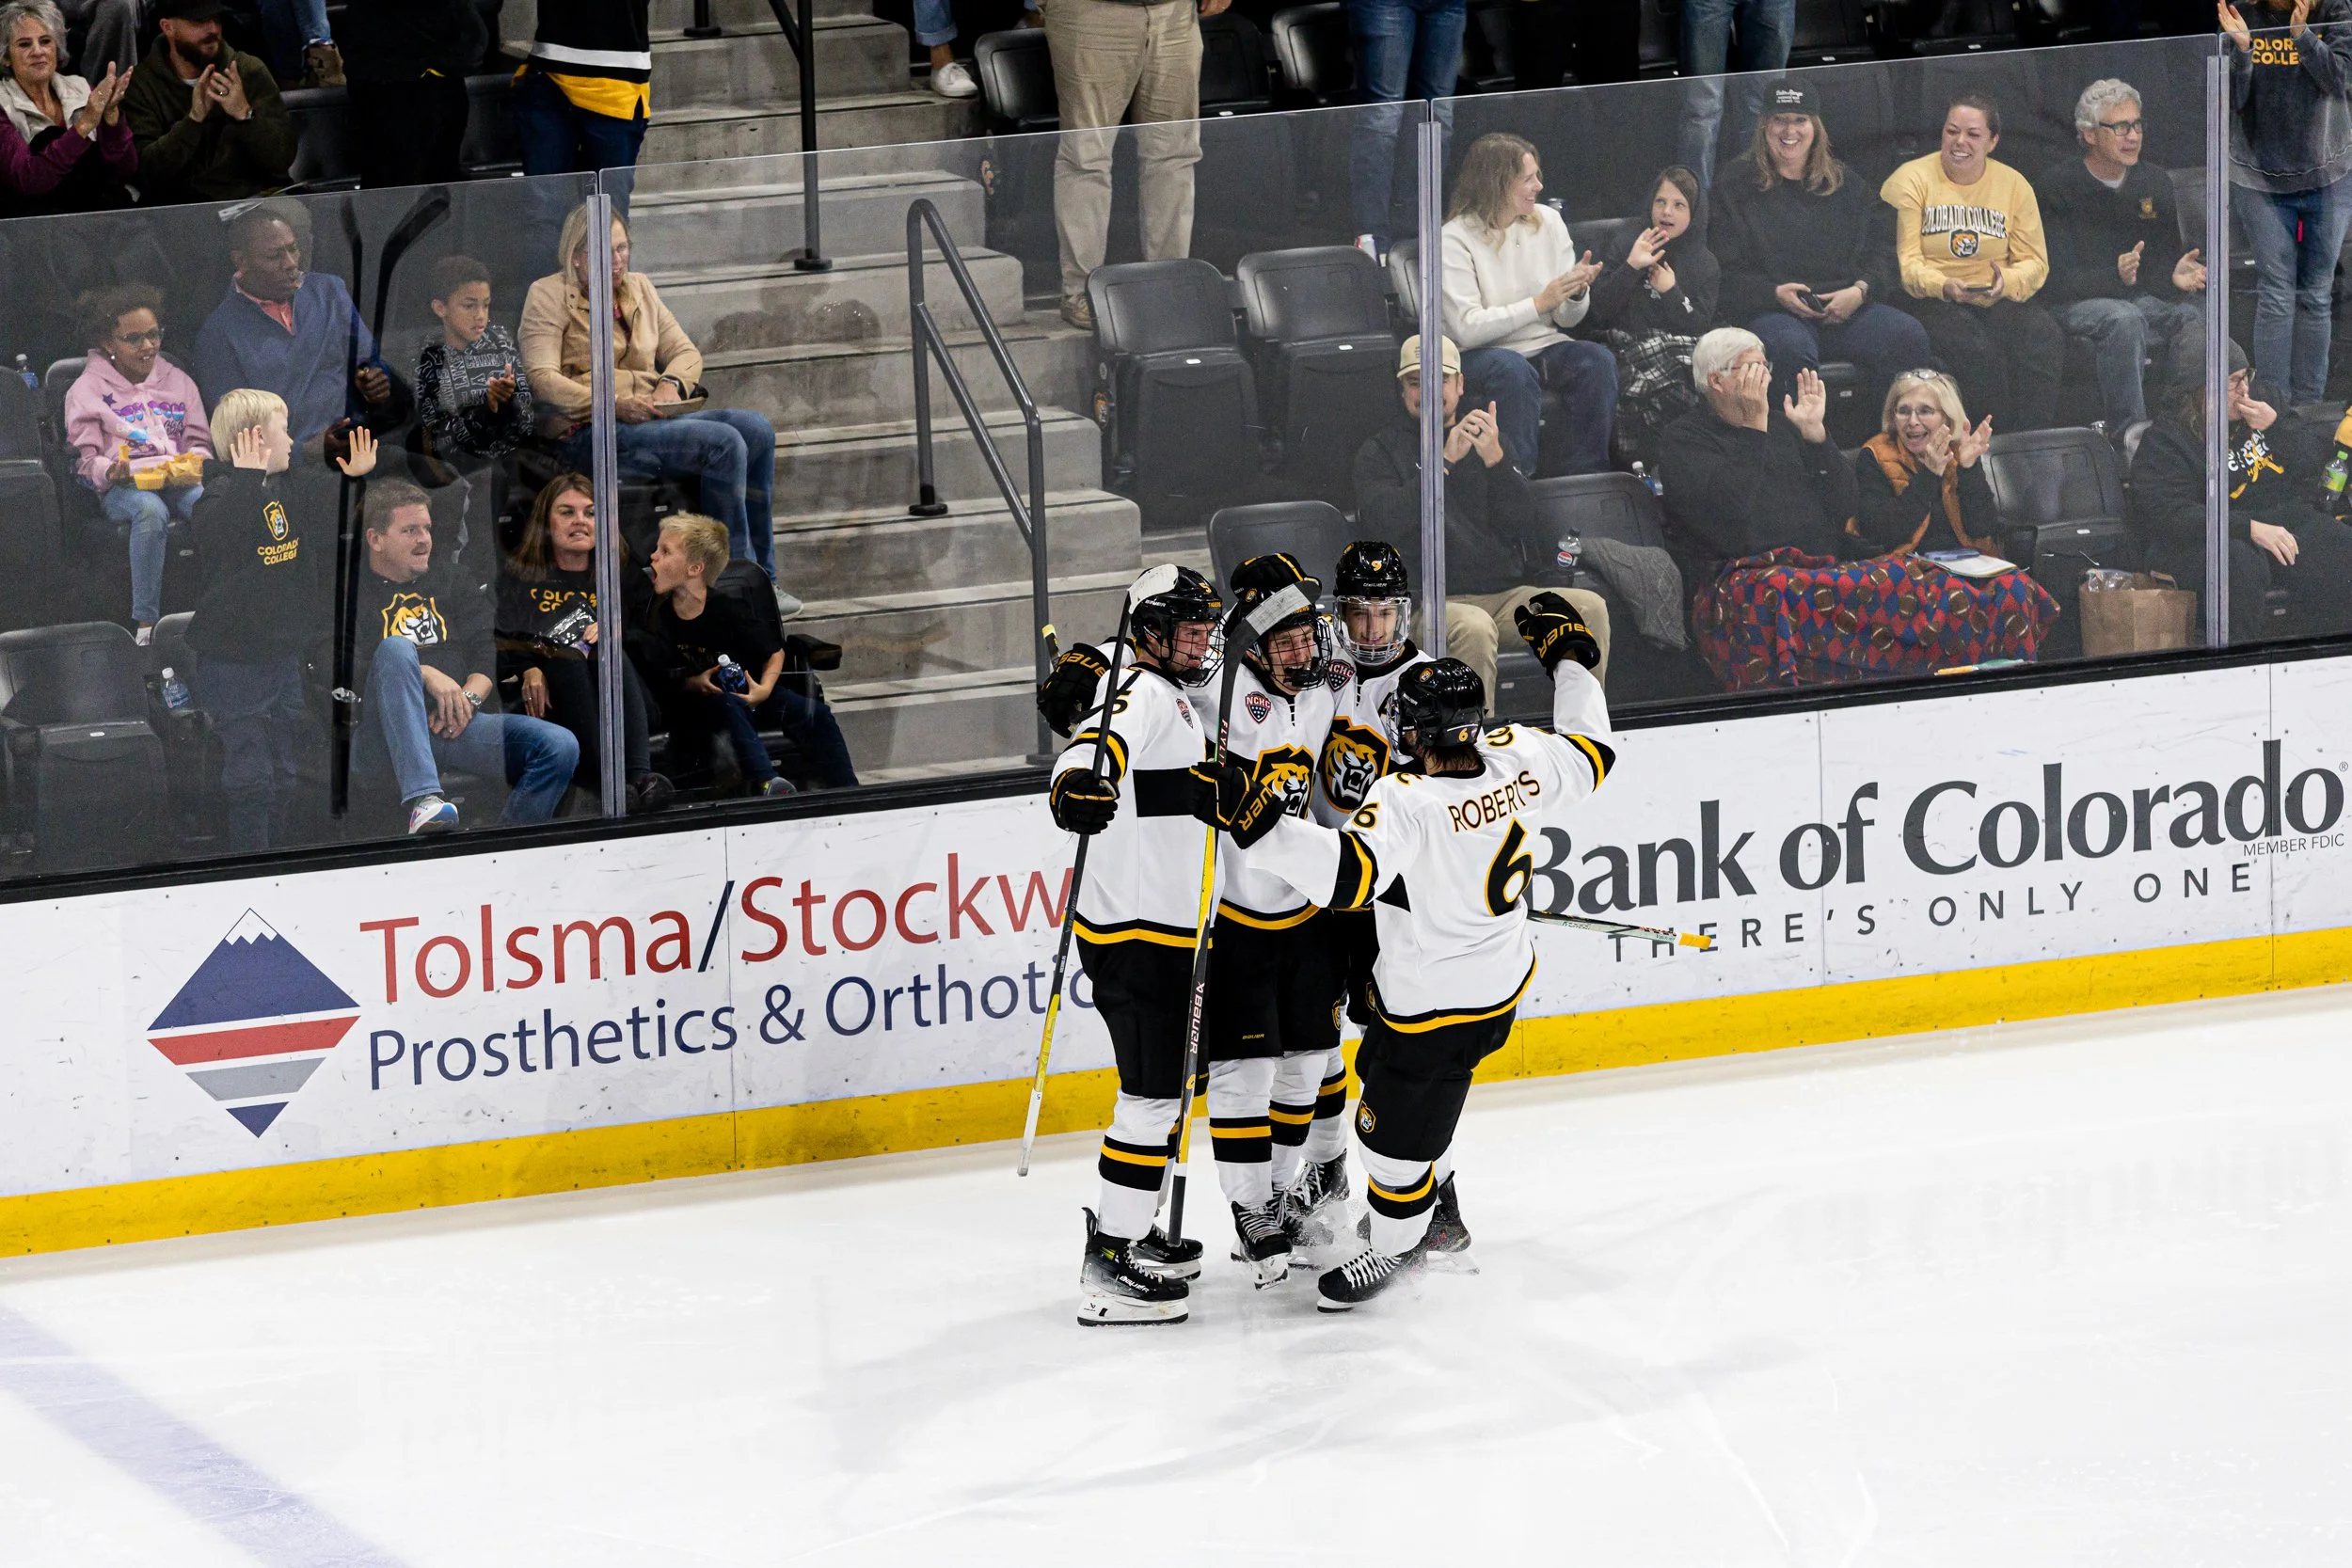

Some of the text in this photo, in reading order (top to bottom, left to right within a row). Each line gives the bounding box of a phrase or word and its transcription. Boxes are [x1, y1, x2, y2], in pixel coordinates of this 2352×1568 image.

[1371, 561, 1382, 571] 9
[1246, 696, 1272, 709] NCHC
[1459, 727, 1469, 742] 6
[1447, 769, 1541, 832] ROBERTS
[1527, 738, 2344, 916] Bank of Colorado
[1485, 816, 1534, 918] 6
[2243, 832, 2345, 857] MEMBER FDIC
[1929, 880, 2084, 927] ONLY
[2133, 862, 2251, 903] ONE
[370, 998, 738, 1090] Prosthetics
[759, 984, 806, 1044] &
[1189, 993, 1203, 1054] BAUER
